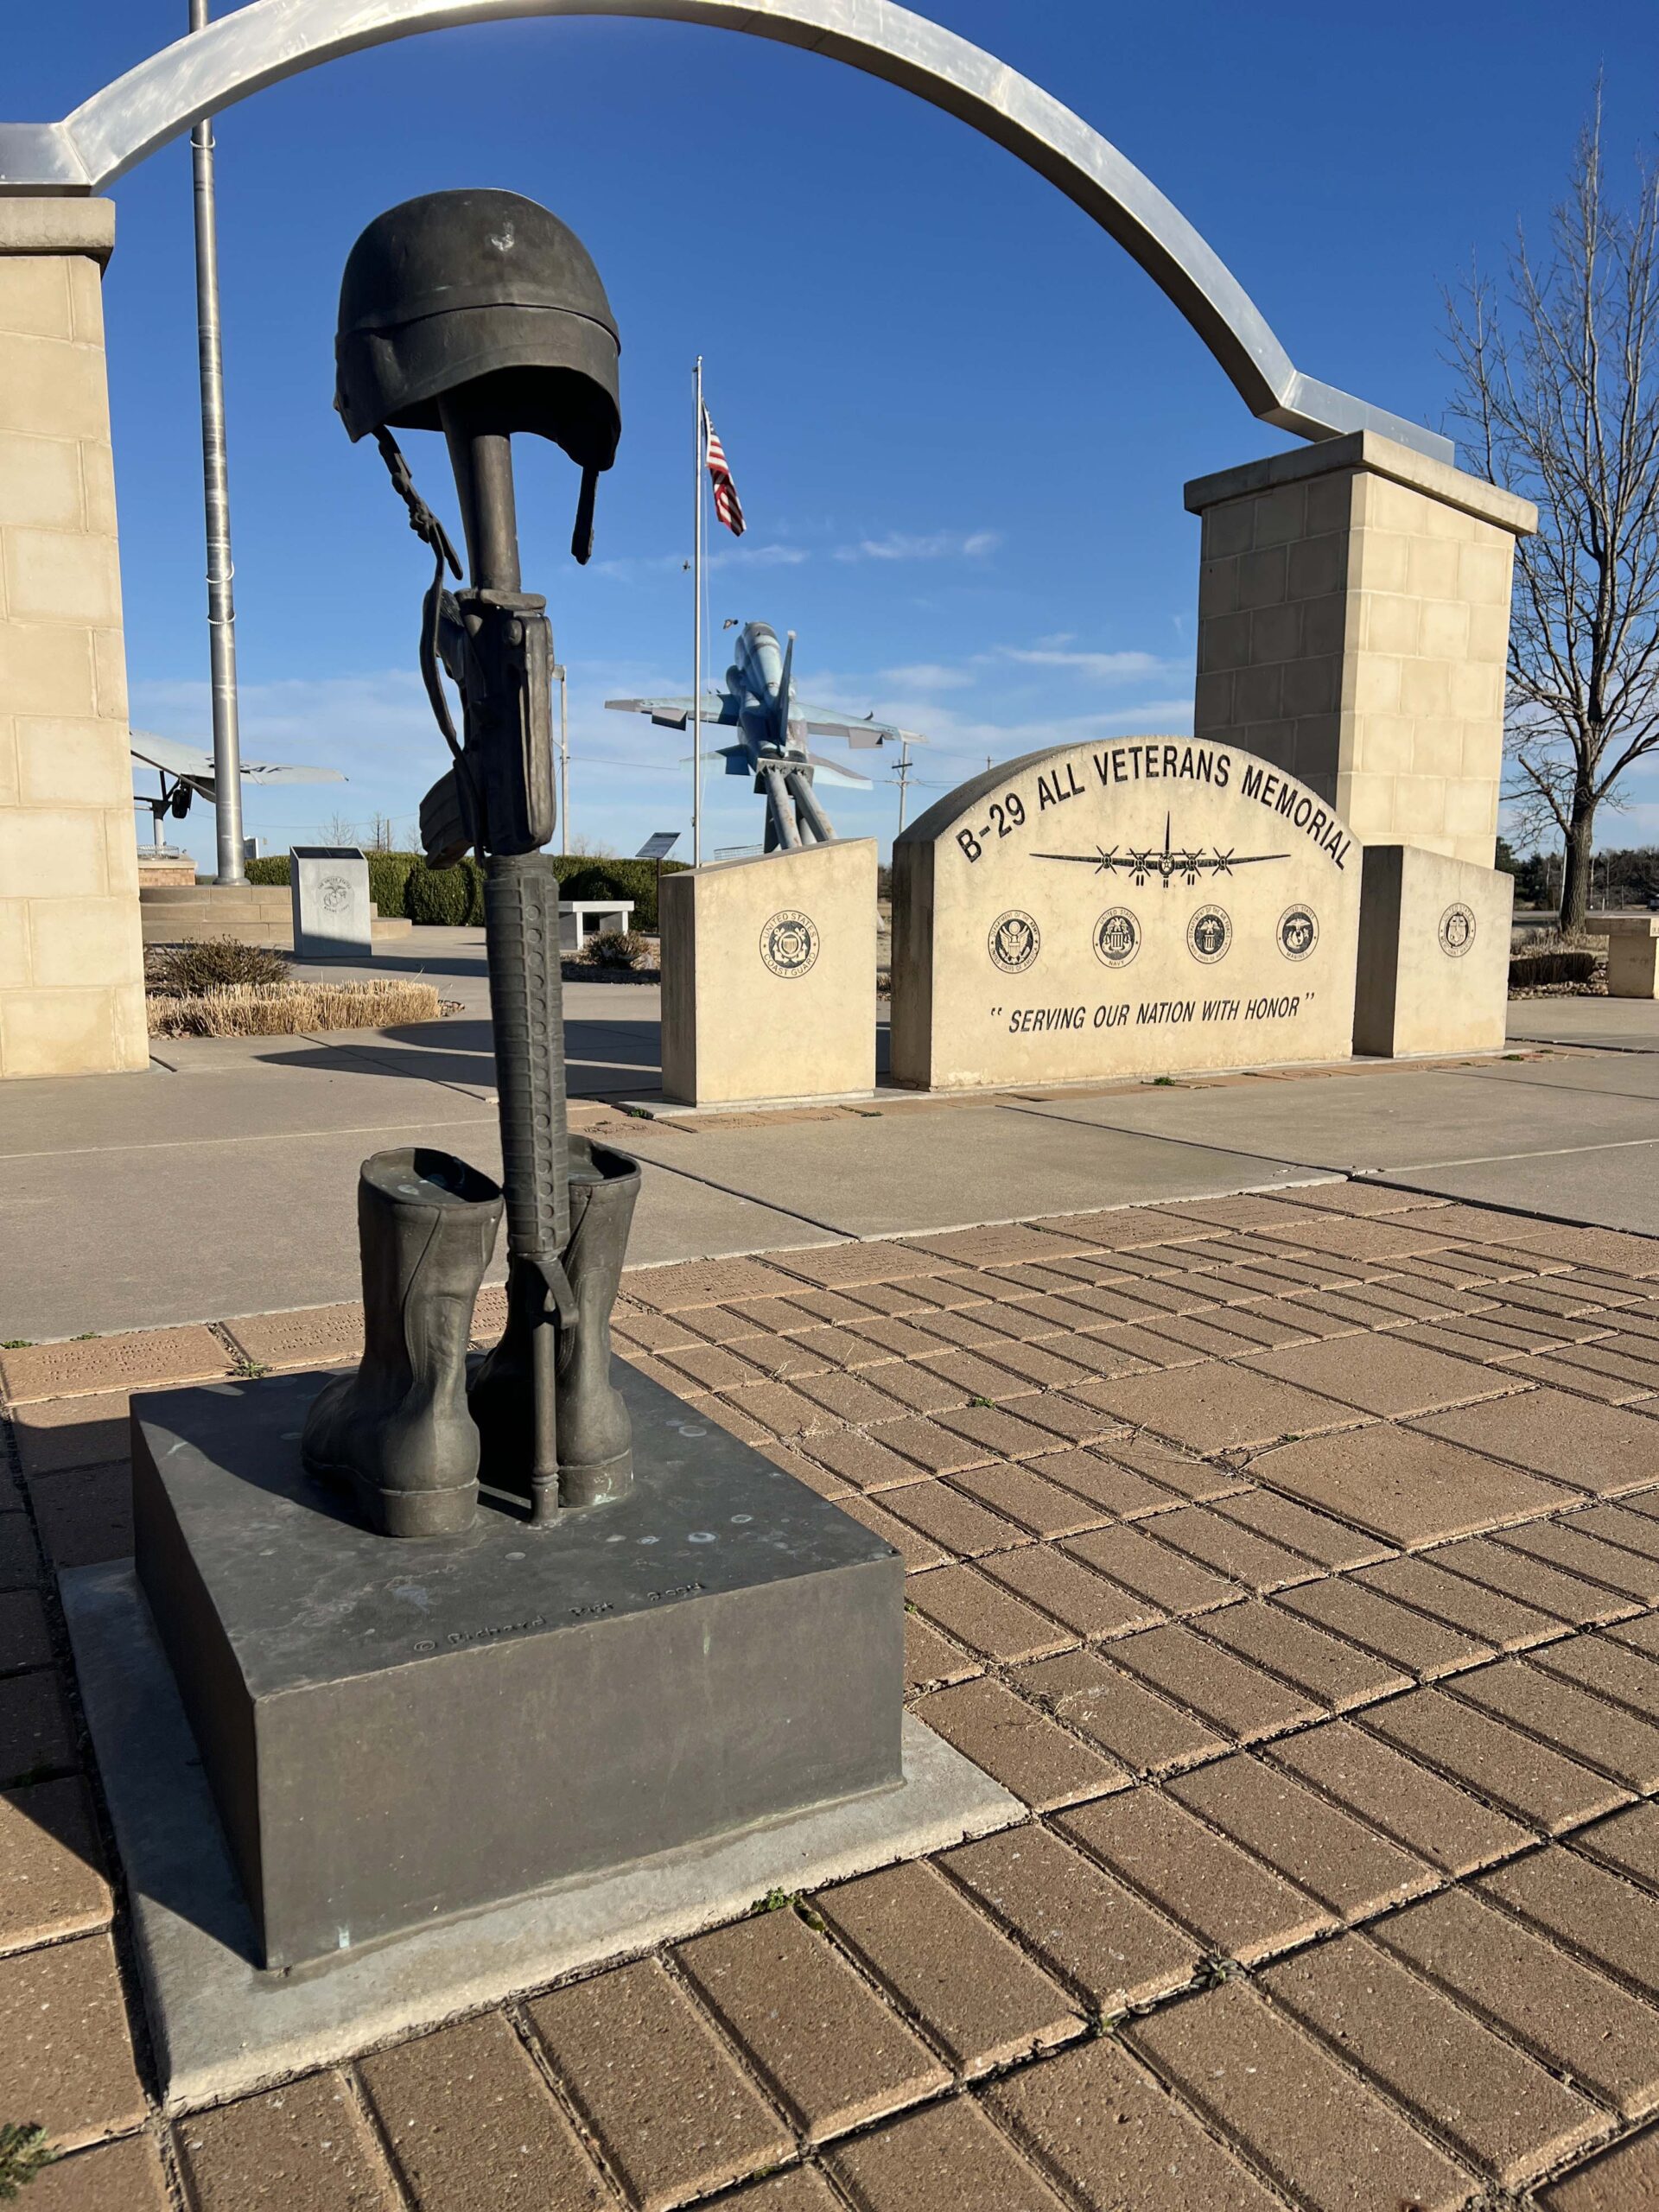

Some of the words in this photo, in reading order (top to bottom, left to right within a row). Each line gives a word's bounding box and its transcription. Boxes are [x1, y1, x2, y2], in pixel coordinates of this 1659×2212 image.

[956, 792, 1026, 864] B-29
[1037, 763, 1086, 811] ALL
[1092, 745, 1231, 788] VETERANS
[1241, 764, 1351, 871] MEMORIAL
[763, 912, 788, 939] UNITED
[791, 912, 817, 938] STATES
[764, 953, 789, 976] COAST
[791, 952, 816, 976] GUARD
[1008, 1006, 1086, 1033] SERVING
[1093, 1003, 1130, 1028] OUR
[1135, 1001, 1197, 1025] NATION
[1201, 1000, 1241, 1021] WITH
[1244, 996, 1300, 1020] HONOR
